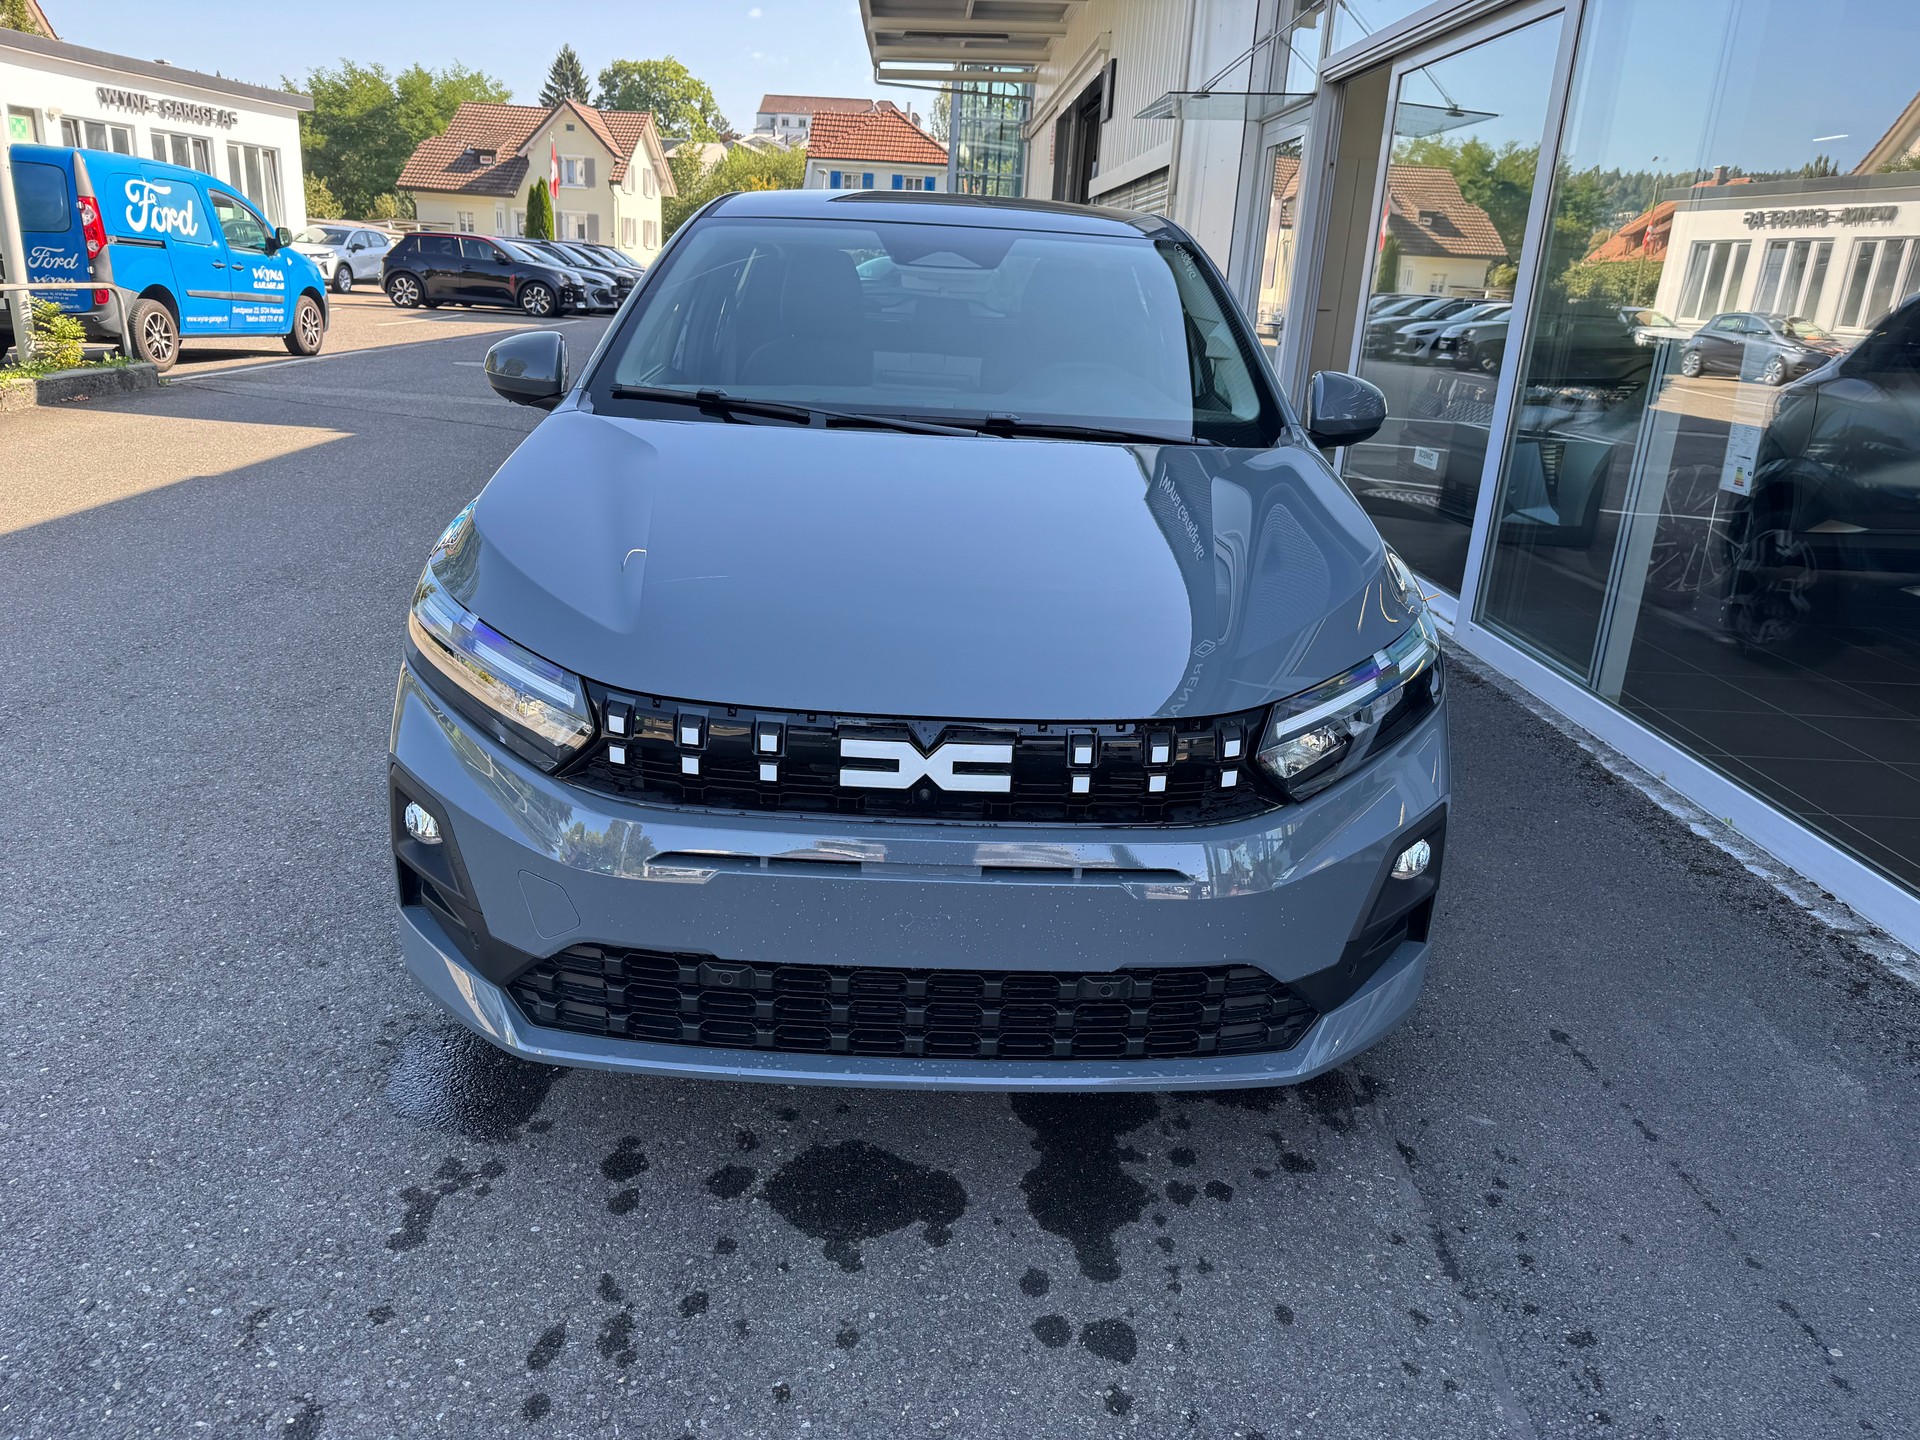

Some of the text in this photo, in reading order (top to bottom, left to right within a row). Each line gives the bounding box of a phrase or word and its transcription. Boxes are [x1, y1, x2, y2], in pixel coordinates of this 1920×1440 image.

[125, 179, 198, 236] Ford
[28, 246, 79, 269] Ford
[252, 265, 285, 281] WYNA
